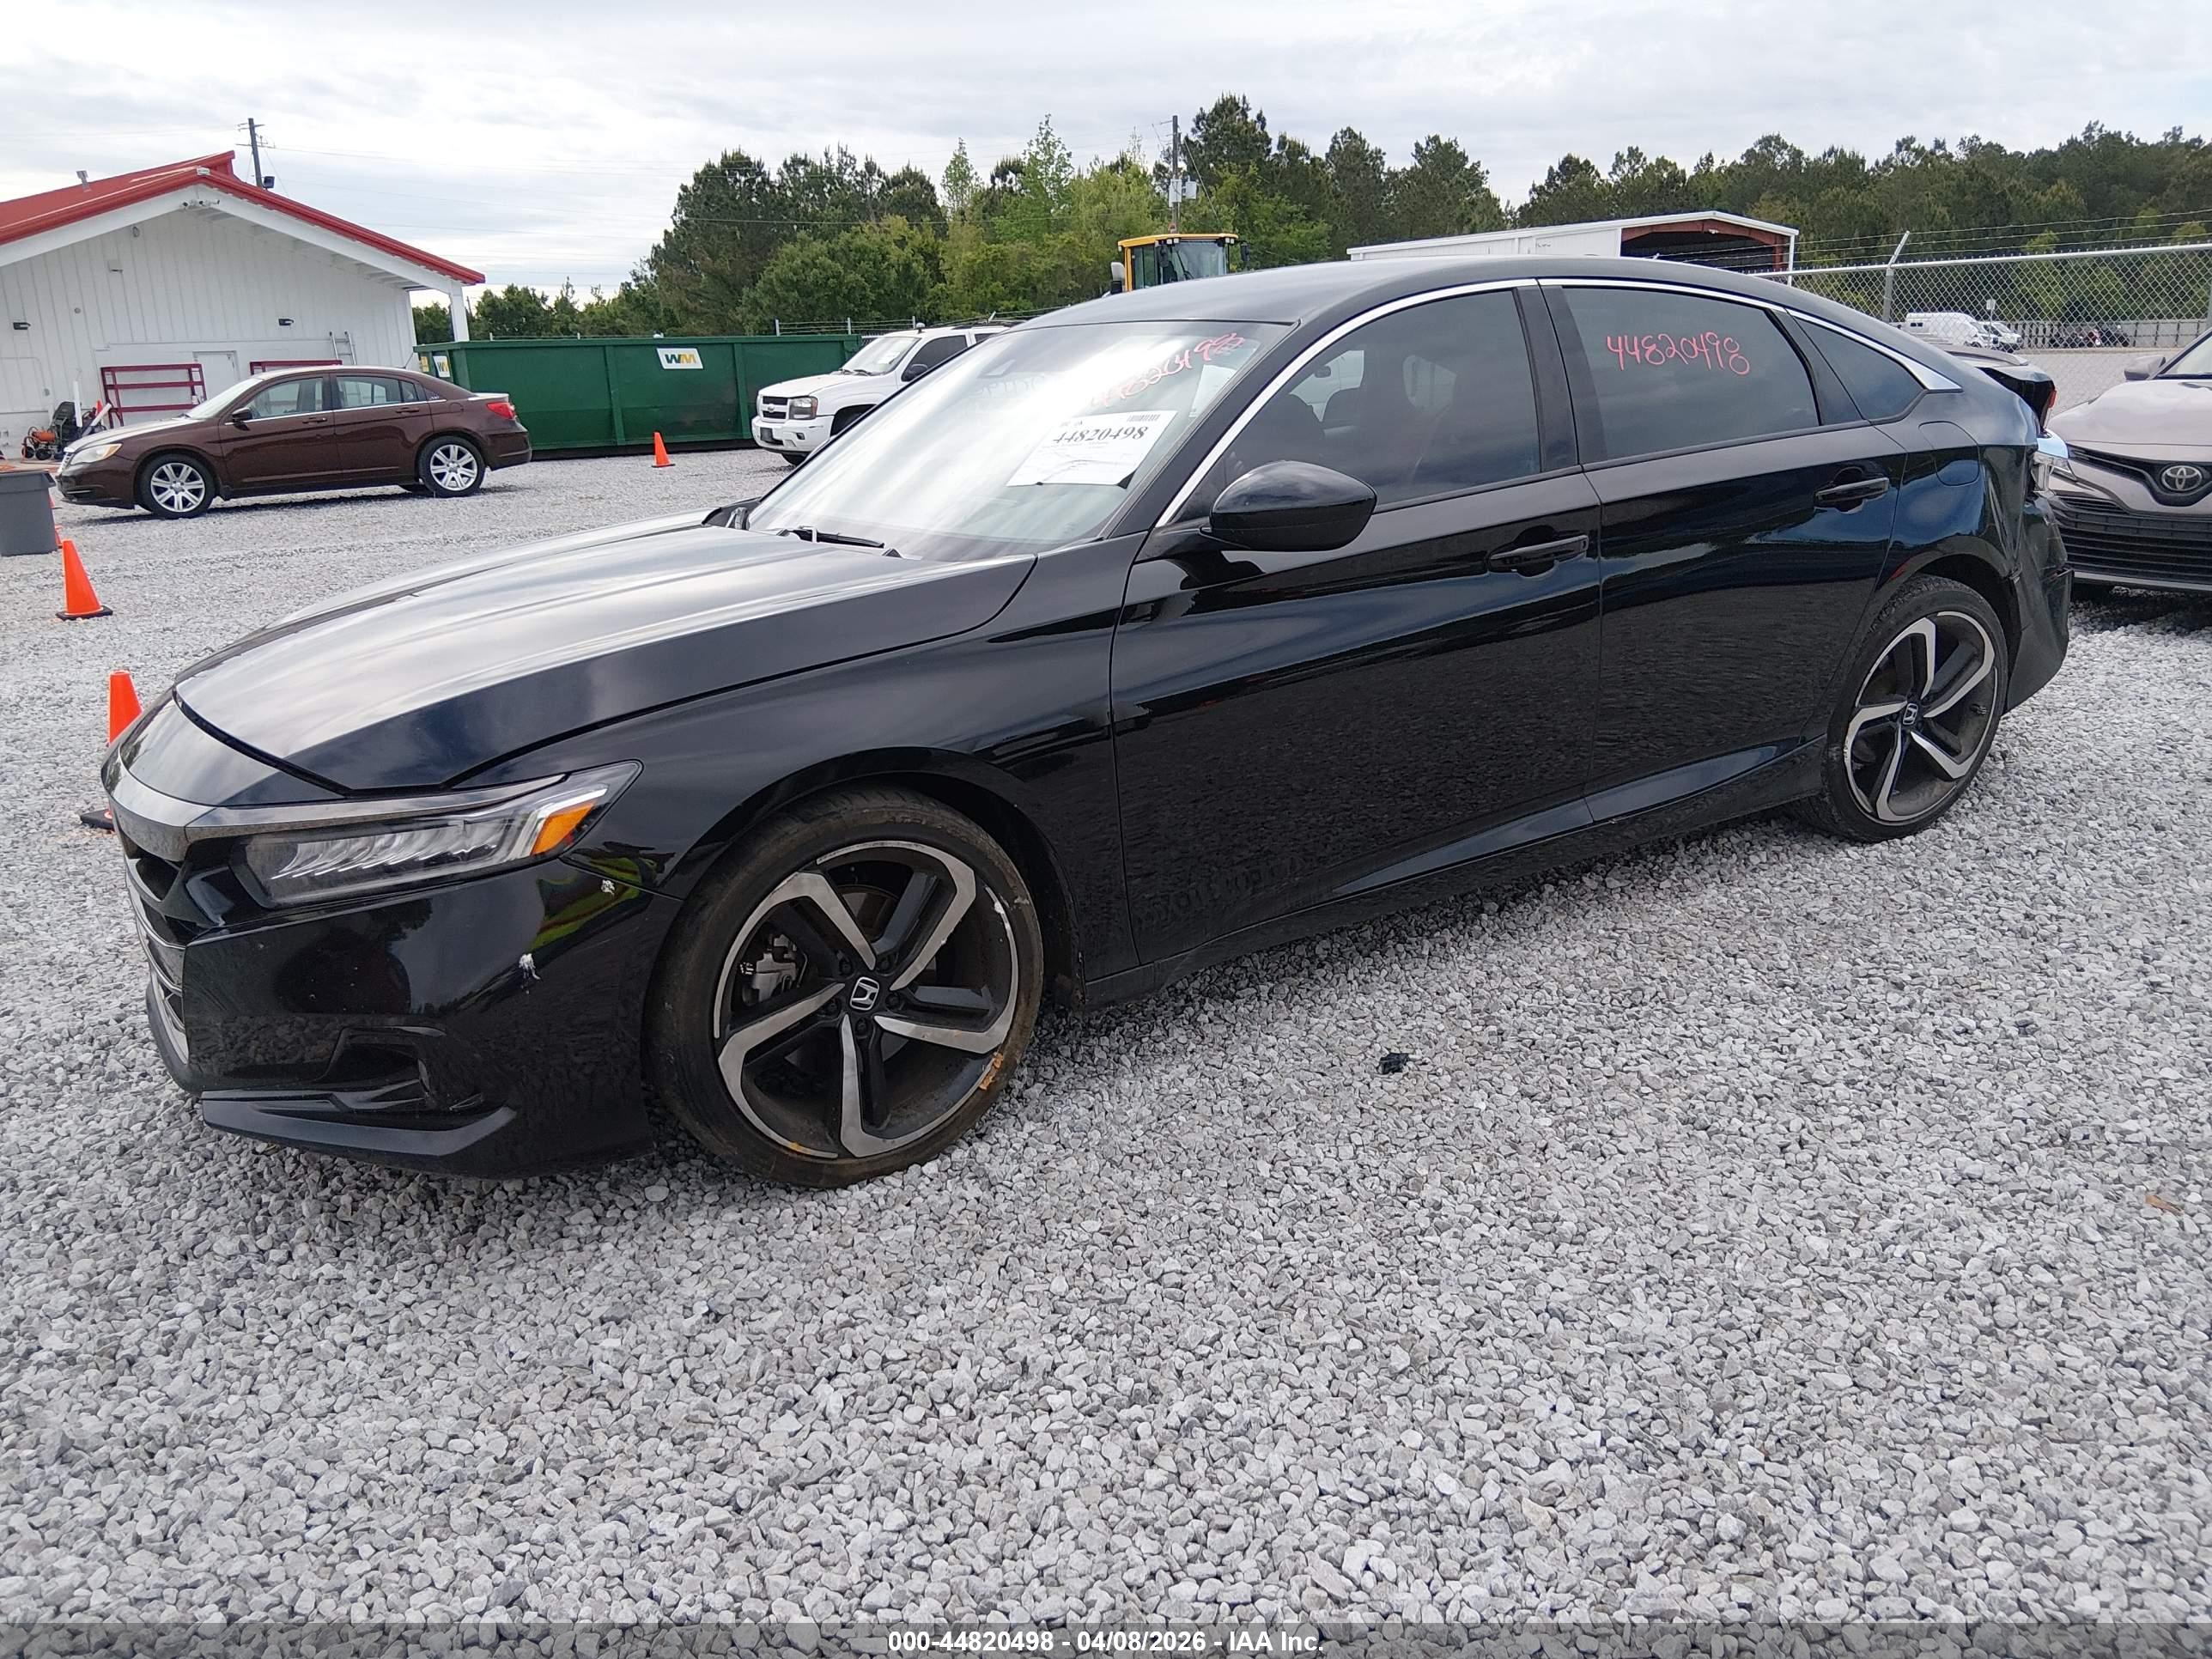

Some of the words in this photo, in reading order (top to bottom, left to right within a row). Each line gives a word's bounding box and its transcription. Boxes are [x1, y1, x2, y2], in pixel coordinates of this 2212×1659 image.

[665, 353, 697, 364] WM
[1607, 330, 1751, 376] 44820498
[1053, 426, 1149, 444] 44820498
